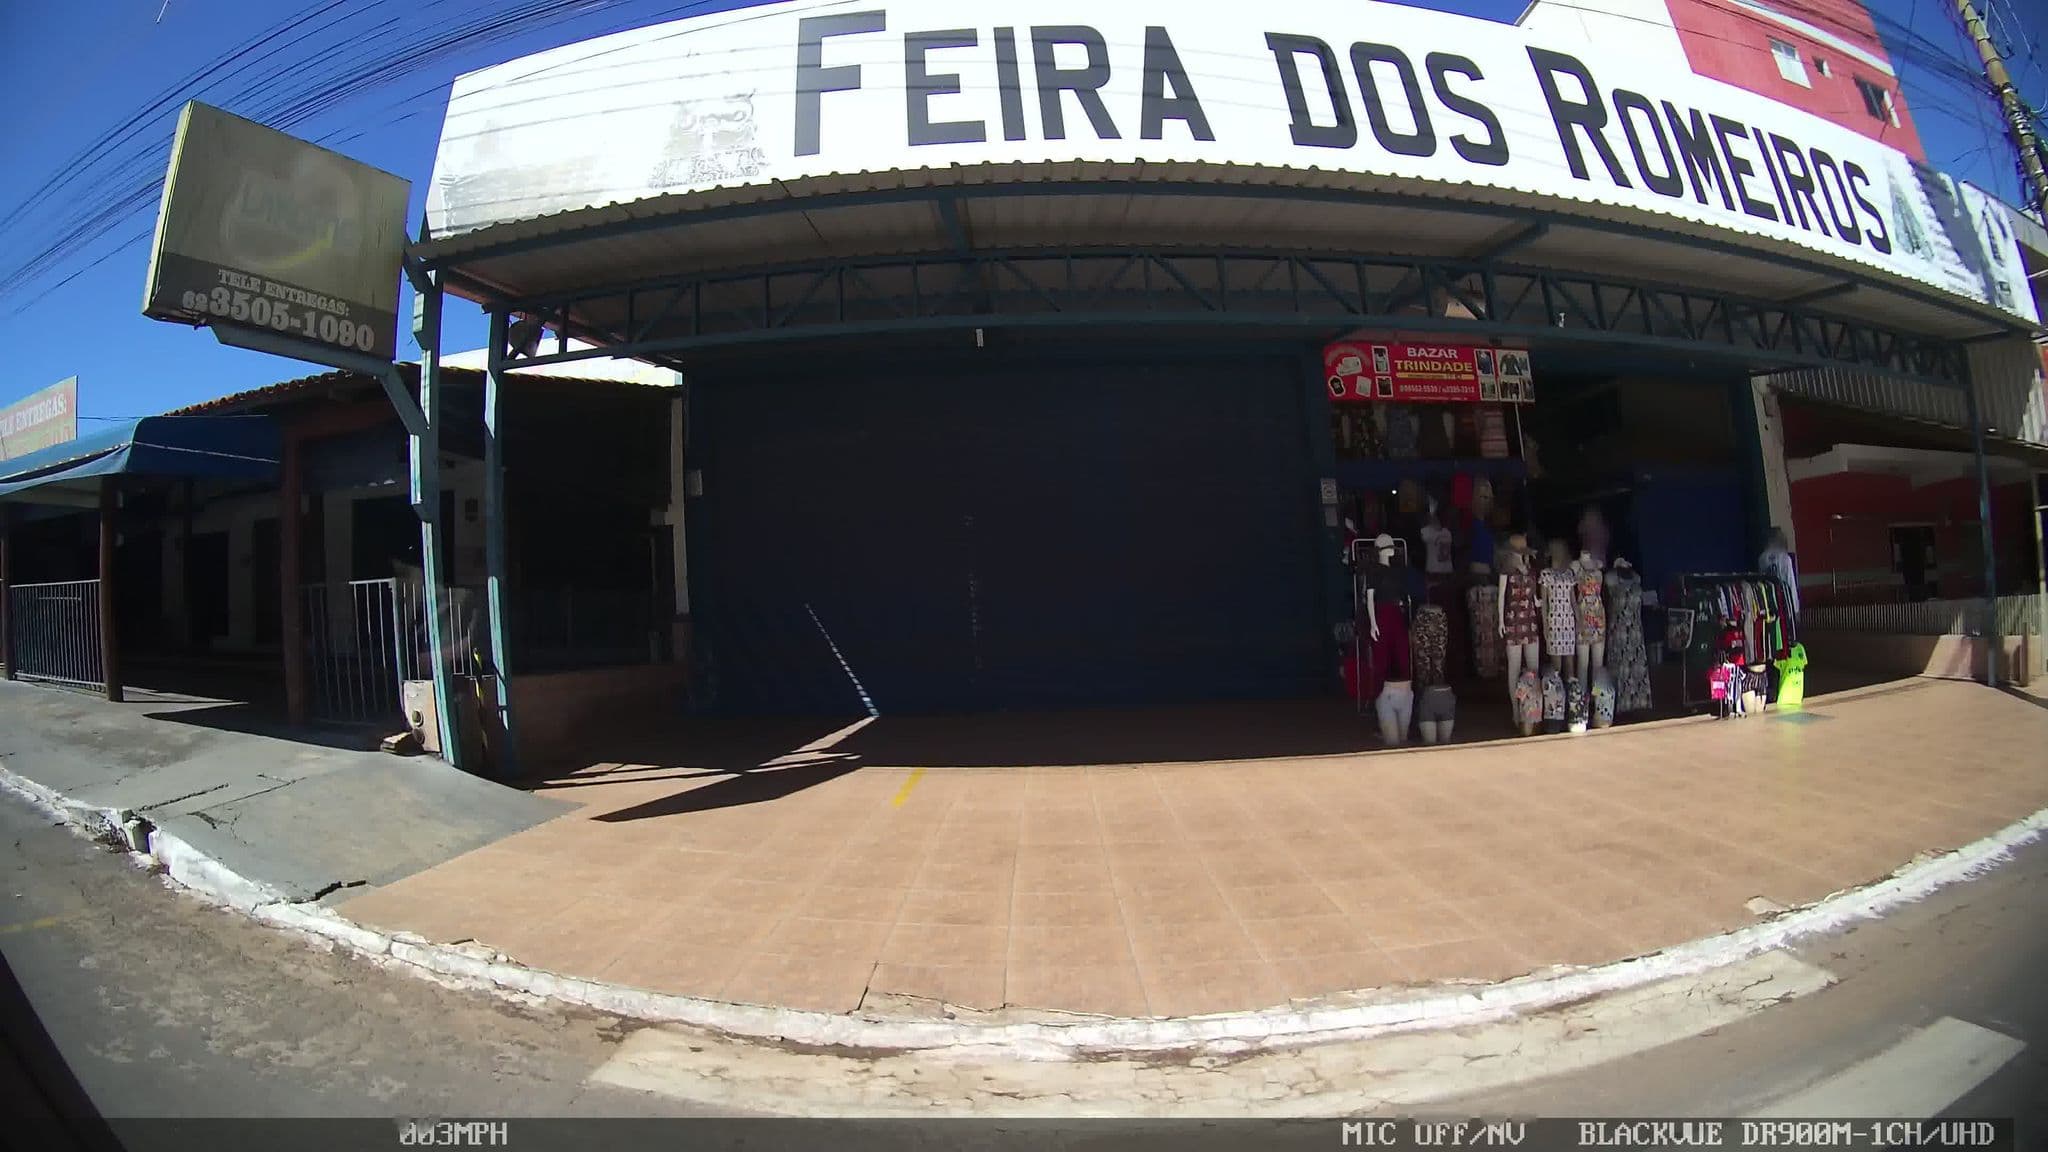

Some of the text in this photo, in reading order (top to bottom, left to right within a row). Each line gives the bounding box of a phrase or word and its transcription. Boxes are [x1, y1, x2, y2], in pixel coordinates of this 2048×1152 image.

[795, 9, 1892, 255] FEIRA DOS ROMEIROS
[218, 268, 350, 316] TELE ENTREGAS:
[1394, 360, 1473, 372] TRINDADE
[1407, 347, 1458, 358] BAZAR
